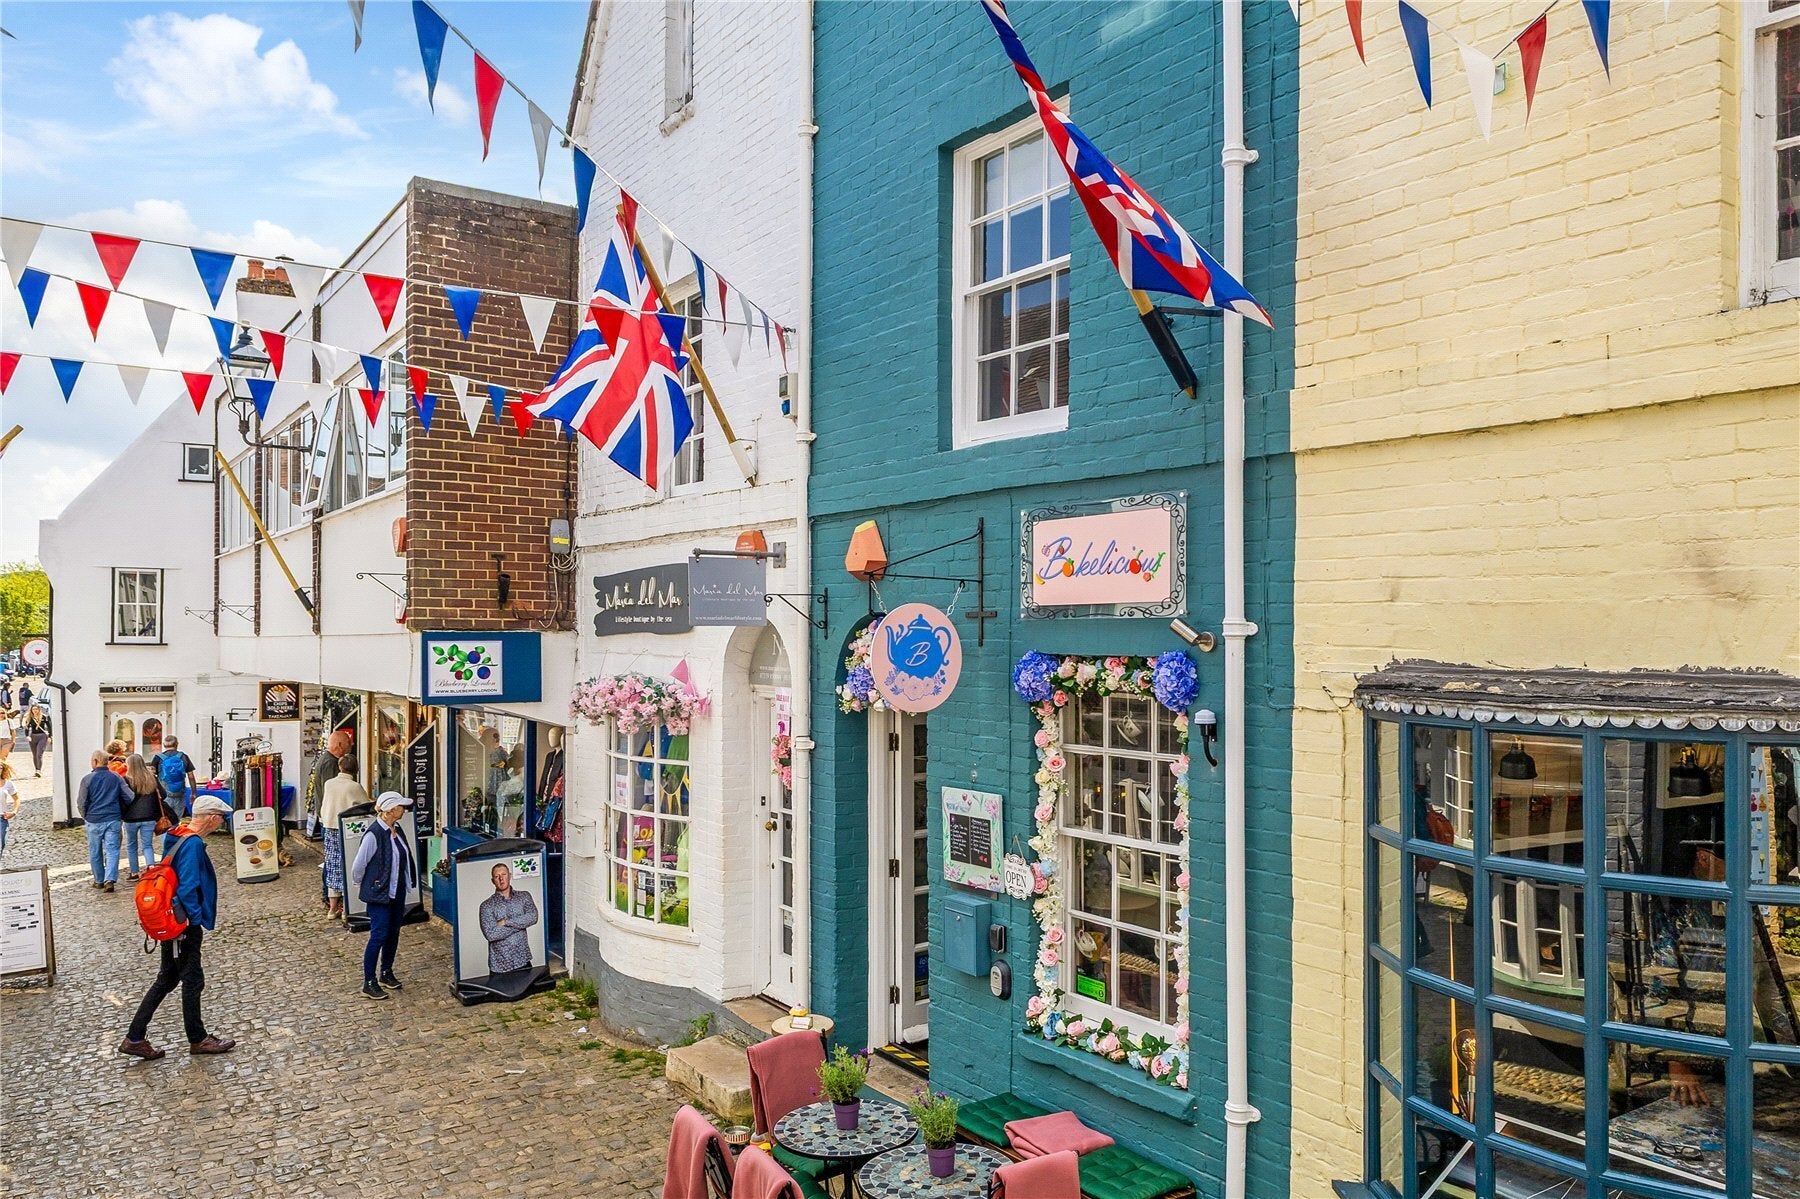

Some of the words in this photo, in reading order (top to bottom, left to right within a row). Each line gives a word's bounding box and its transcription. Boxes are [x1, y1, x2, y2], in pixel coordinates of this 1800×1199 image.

[1037, 537, 1166, 580] Bakelicious
[605, 582, 635, 610] Maria
[638, 576, 657, 606] del
[658, 581, 683, 608] Mar
[693, 584, 722, 595] Maria
[726, 582, 741, 594] del
[745, 585, 763, 596] Mar
[906, 642, 931, 666] B
[1005, 870, 1027, 889] OPEN
